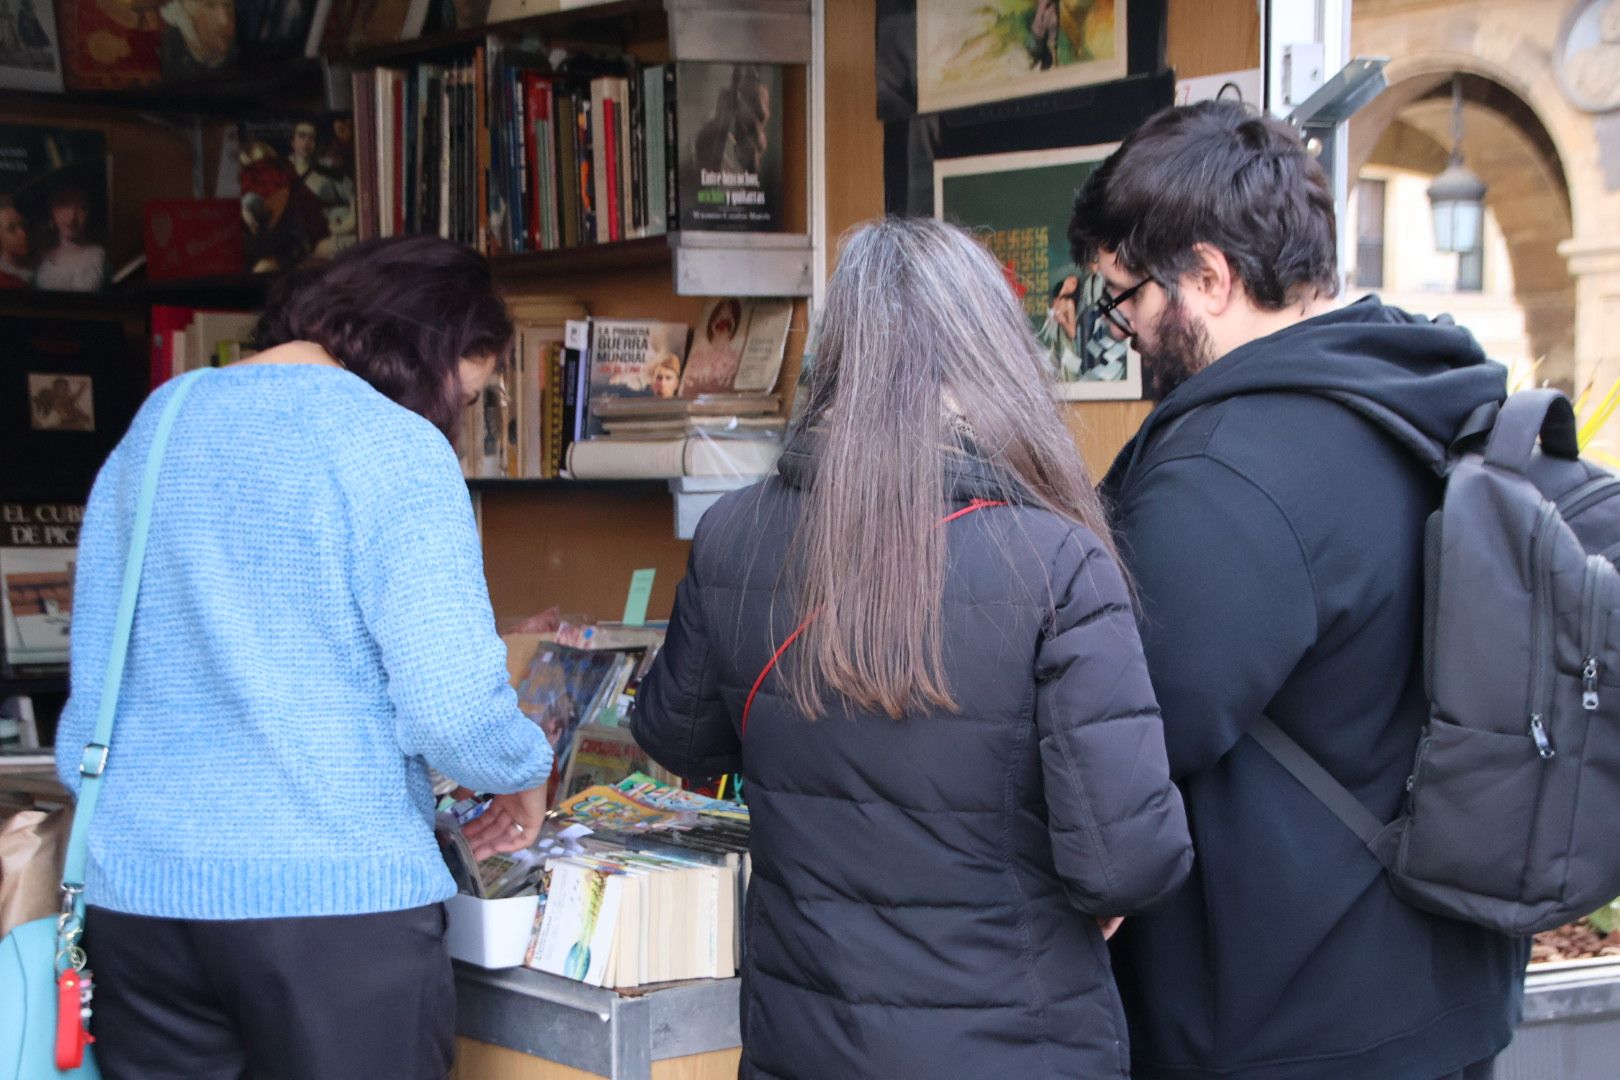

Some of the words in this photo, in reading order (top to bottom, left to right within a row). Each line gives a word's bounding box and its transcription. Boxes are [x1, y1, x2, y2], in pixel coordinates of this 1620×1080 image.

[599, 327, 609, 335] LA
[613, 328, 650, 336] PRIMERA
[599, 336, 648, 350] GUERRA
[597, 352, 646, 363] MUNDIAL
[3, 504, 32, 522] EL
[35, 504, 86, 523] CUB
[11, 526, 41, 544] DE
